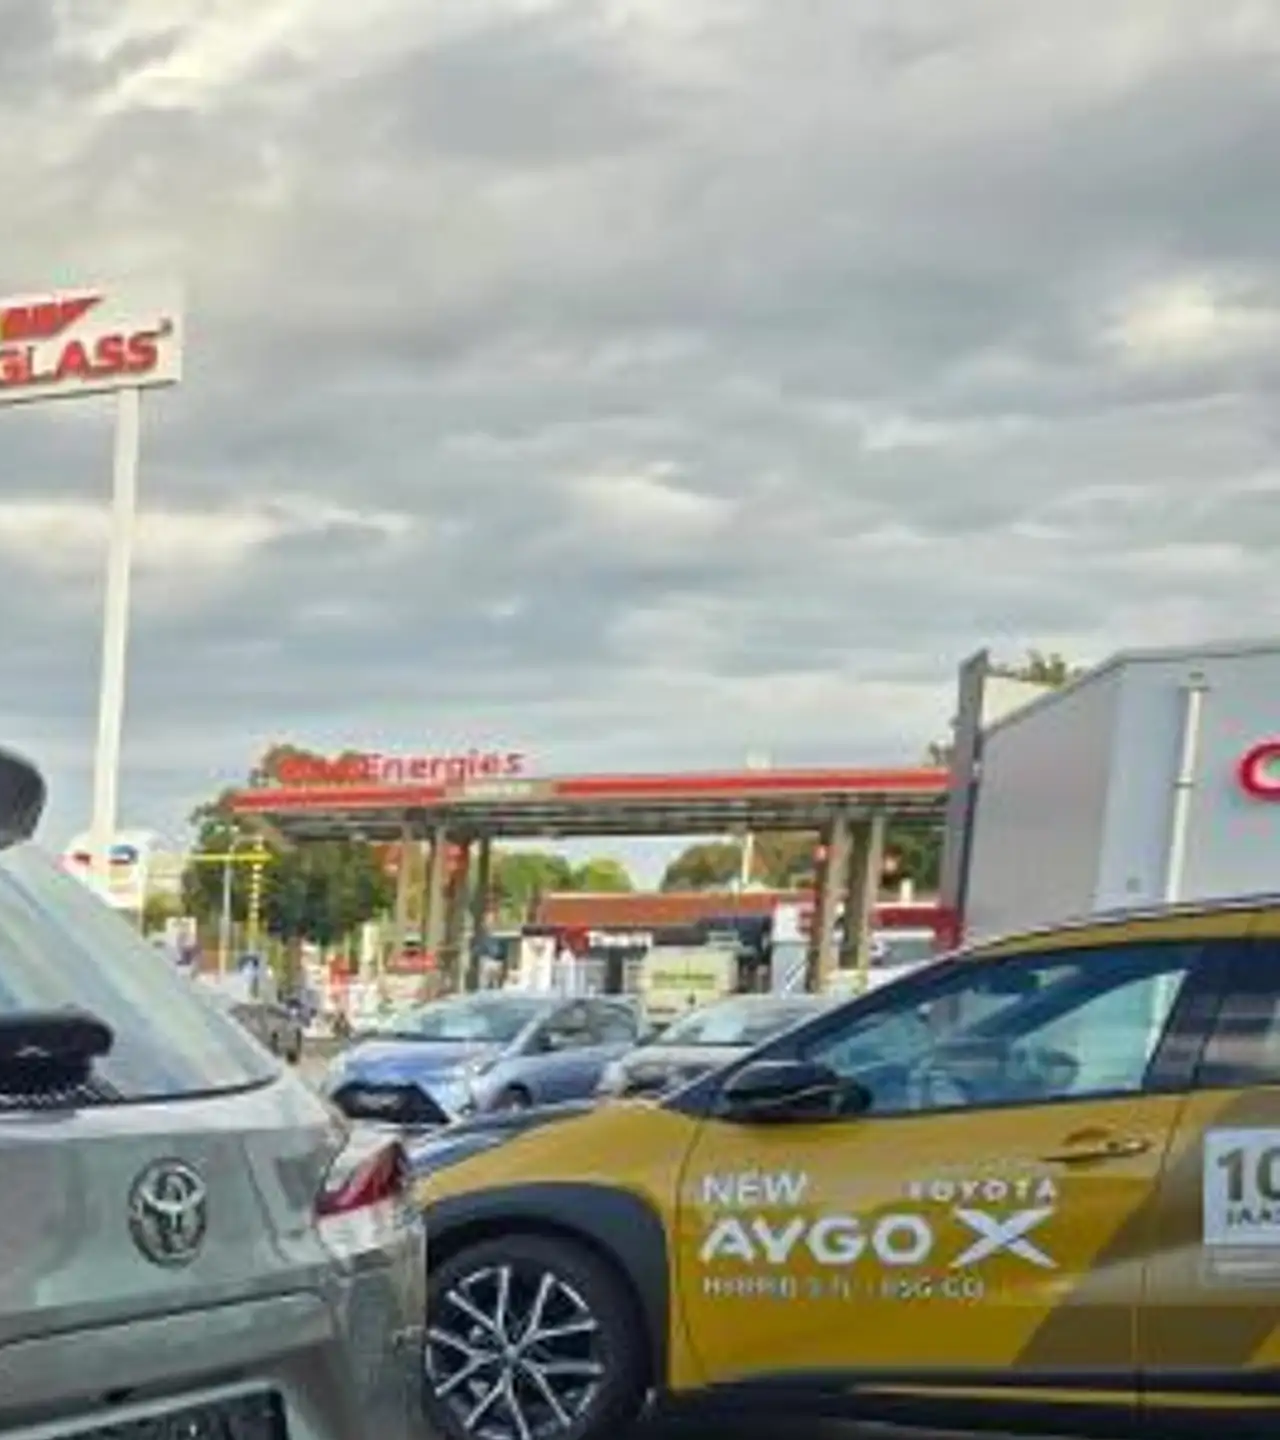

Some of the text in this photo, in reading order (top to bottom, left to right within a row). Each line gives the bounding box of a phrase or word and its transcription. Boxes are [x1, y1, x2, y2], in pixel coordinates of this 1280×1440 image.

[701, 1172, 807, 1204] NEW
[908, 1177, 1058, 1203] TOYOTA
[700, 1205, 1060, 1269] AYGO X
